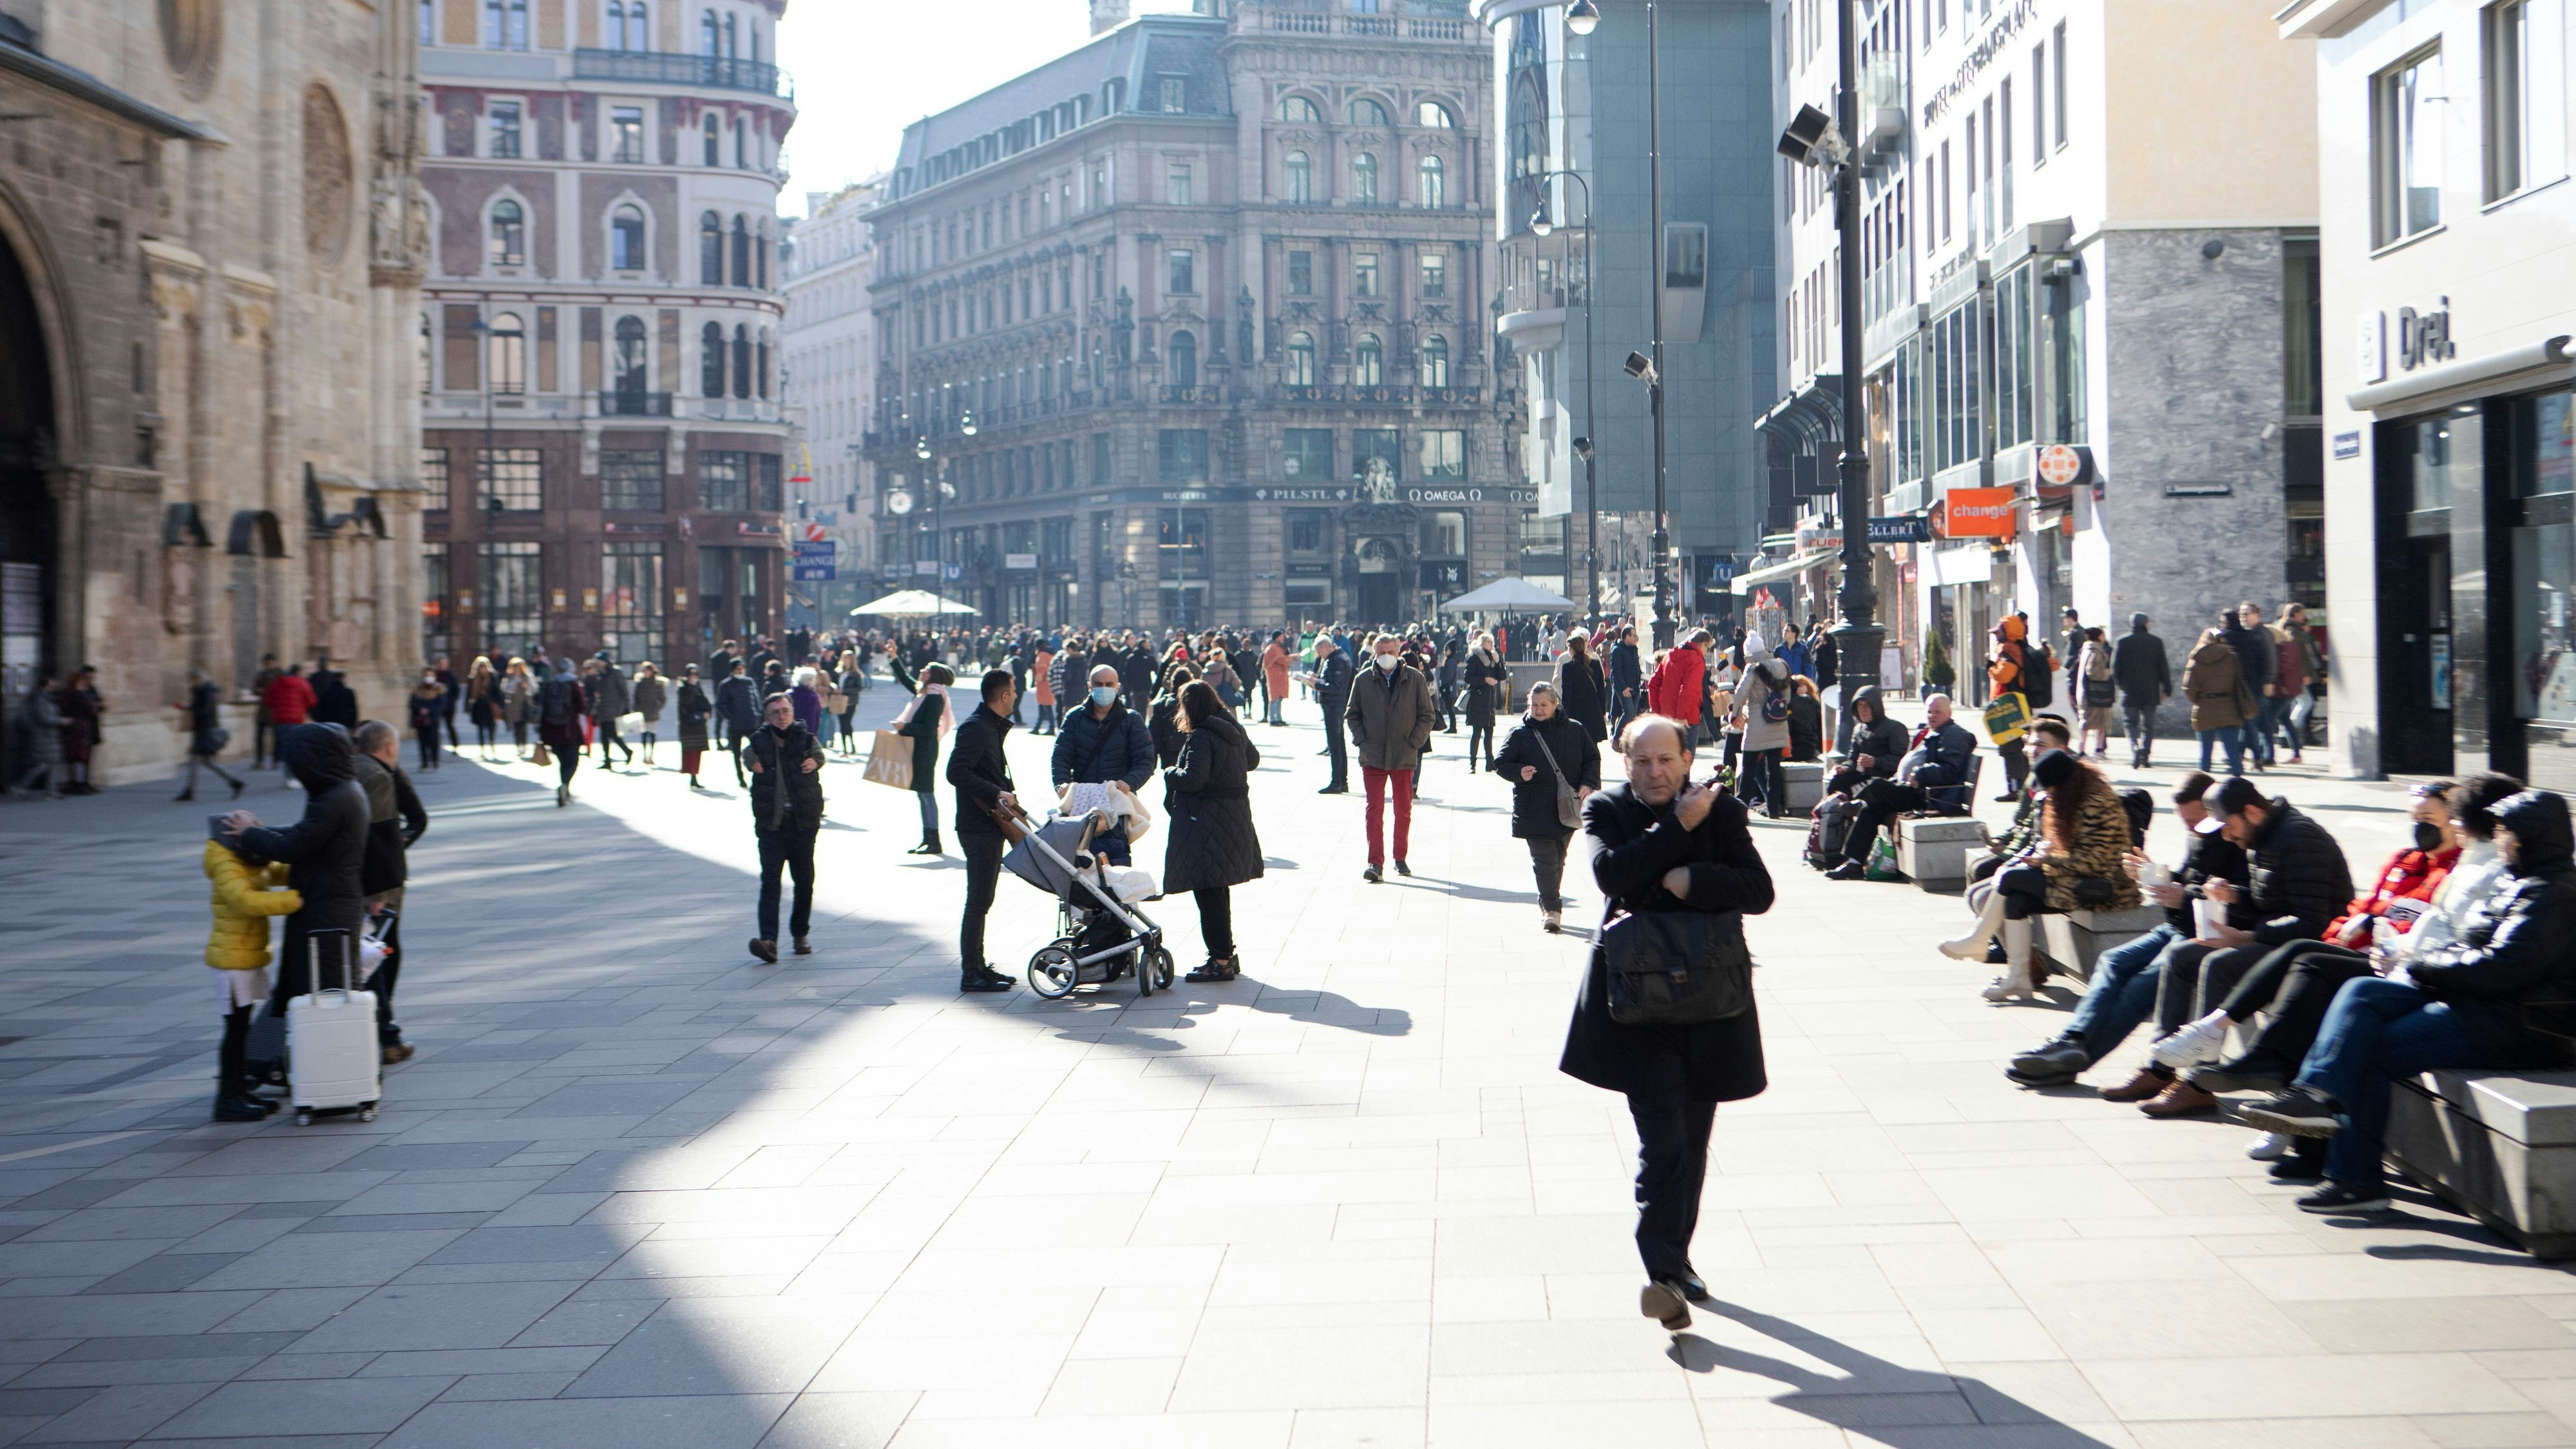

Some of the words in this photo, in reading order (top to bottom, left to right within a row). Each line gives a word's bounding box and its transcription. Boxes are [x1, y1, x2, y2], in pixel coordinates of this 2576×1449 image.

[1273, 489, 1330, 499] PILSTL
[1424, 490, 1466, 501] OMEGA
[1953, 504, 2009, 519] change
[948, 566, 960, 579] U
[1719, 567, 1732, 582] U
